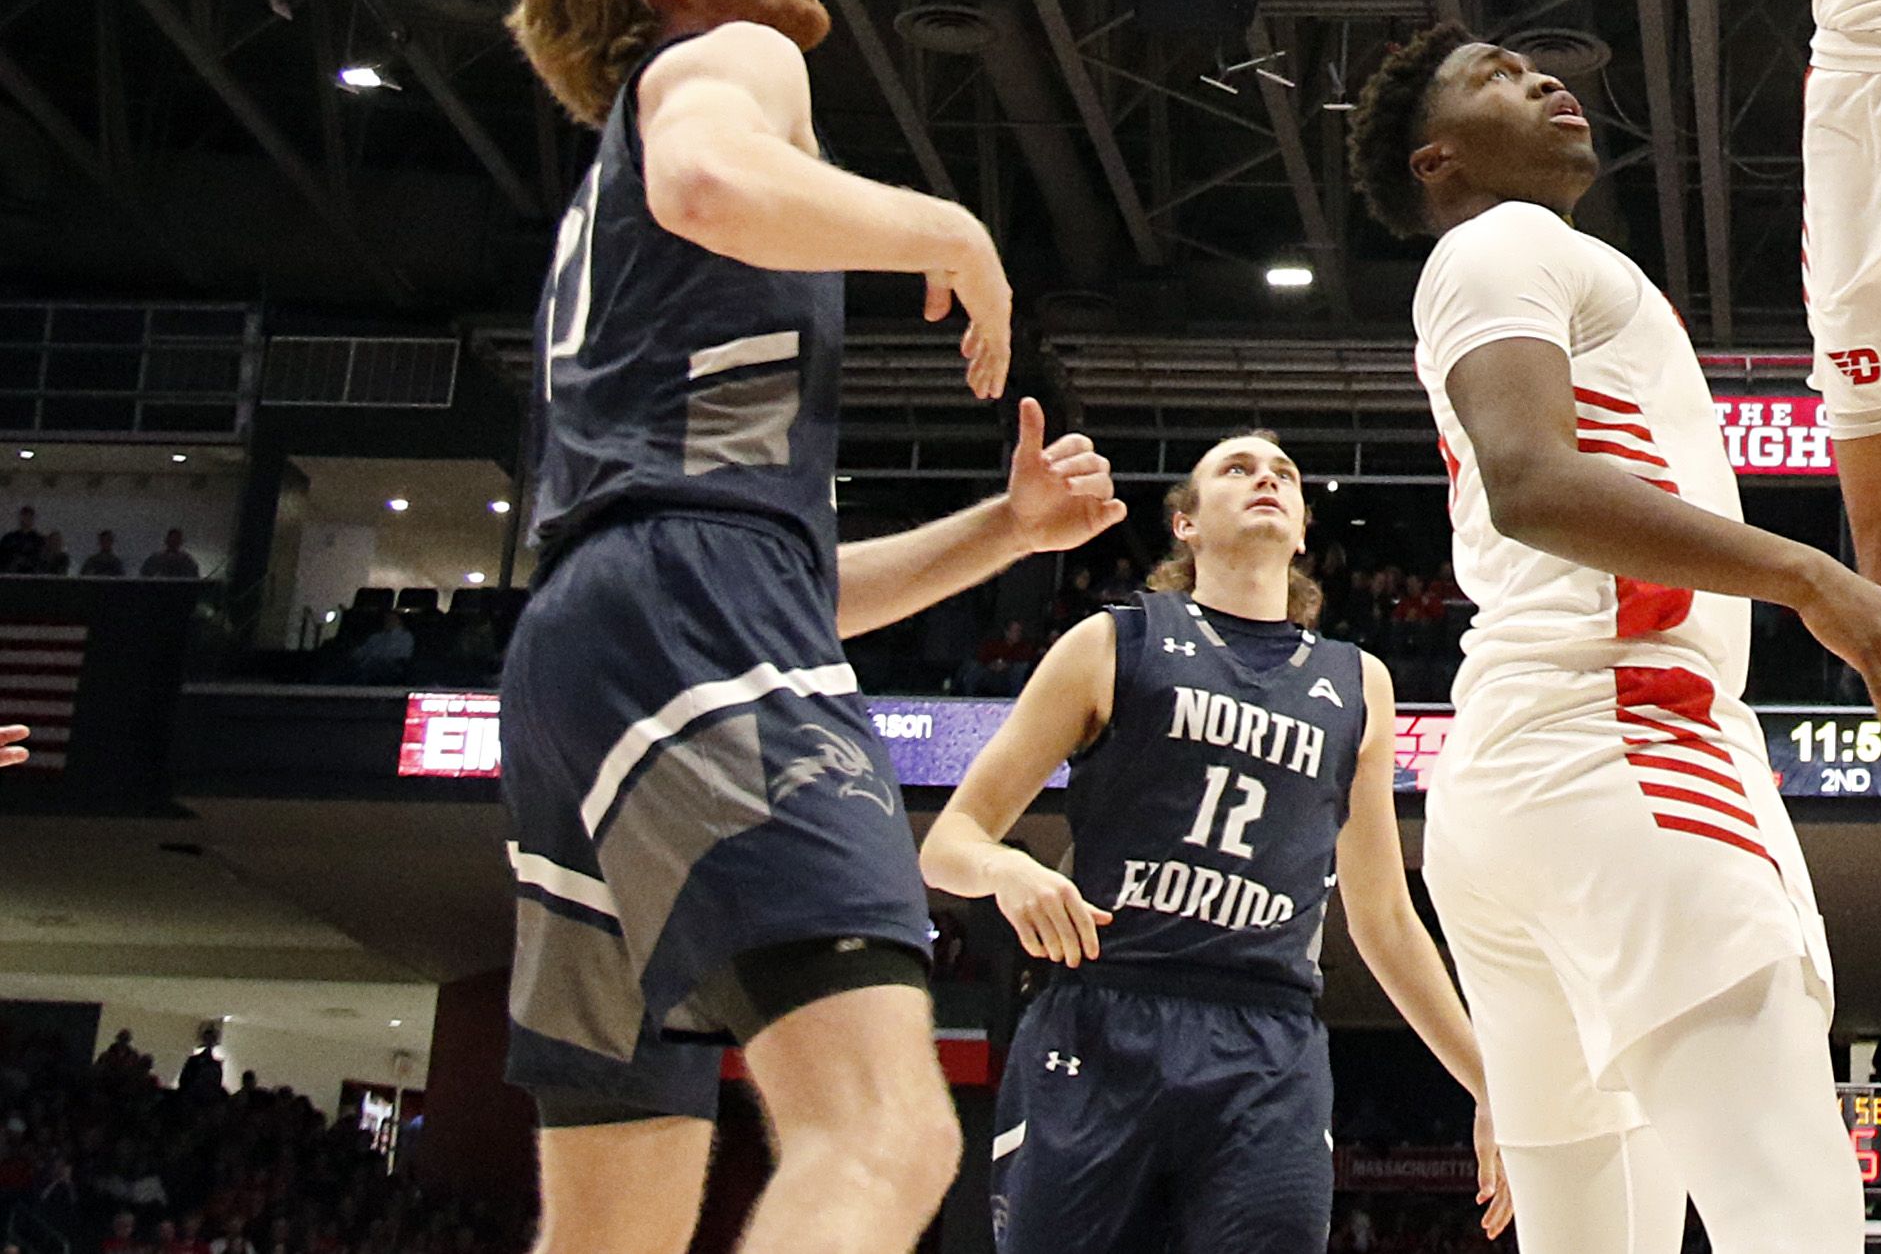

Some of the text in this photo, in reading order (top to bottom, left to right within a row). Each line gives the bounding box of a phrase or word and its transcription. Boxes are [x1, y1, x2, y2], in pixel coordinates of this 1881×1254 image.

[1713, 402, 1793, 428] THE
[1723, 426, 1832, 468] IGH
[872, 713, 933, 739] ason
[1168, 686, 1325, 778] NORTH
[1820, 767, 1872, 793] 2ND
[1183, 764, 1268, 860] 12
